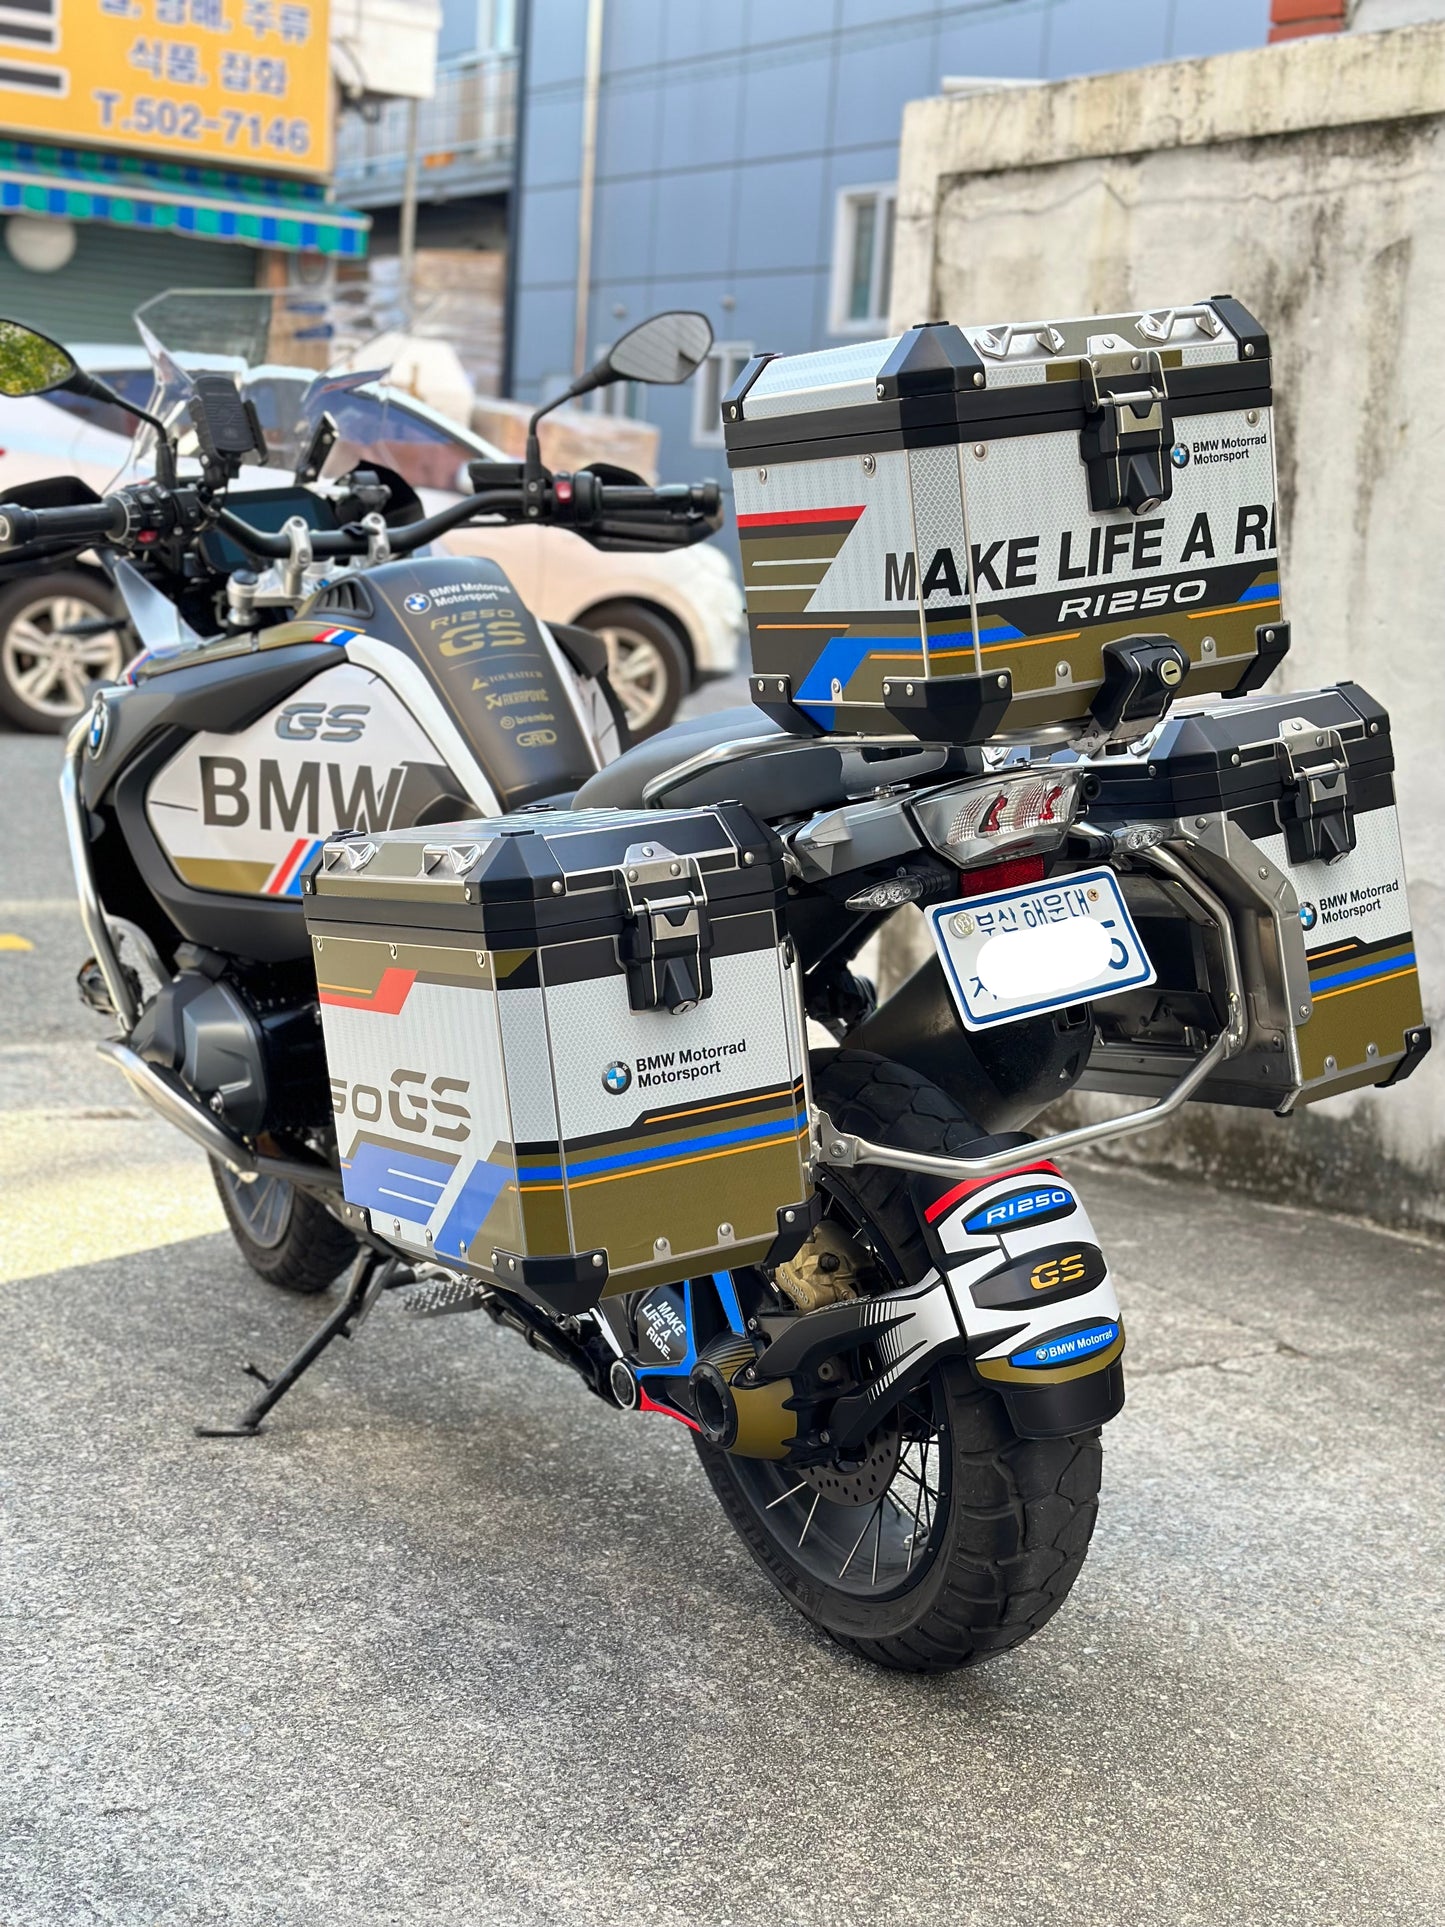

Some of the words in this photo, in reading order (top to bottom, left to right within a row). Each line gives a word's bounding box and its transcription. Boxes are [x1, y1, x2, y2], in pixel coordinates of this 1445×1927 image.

[95, 91, 310, 154] T.502-7146
[1193, 440, 1219, 453] BMW
[1222, 434, 1267, 449] Motorrad
[1194, 449, 1249, 465] Motorsport
[885, 536, 1039, 601] MAKE
[1058, 518, 1165, 581] LIFE
[1180, 512, 1215, 563] A
[429, 584, 461, 598] BMW
[461, 582, 511, 595] Motorrad
[434, 592, 499, 607] Motorsport
[1057, 579, 1208, 623] R1250
[430, 609, 516, 631] R1250
[439, 621, 527, 657] GS
[275, 702, 371, 742] GS
[515, 711, 555, 725] brembo
[199, 755, 405, 835] BMW
[1319, 893, 1347, 911] BMW
[1350, 879, 1399, 902] Motorrad
[1321, 899, 1381, 924] Motorsport
[975, 906, 1019, 936] 부산
[1020, 888, 1090, 928] 해운대
[636, 1052, 675, 1072] BMW
[679, 1039, 747, 1064] Motorrad
[638, 1060, 721, 1088] Motorsport
[986, 1191, 1066, 1224] R1250
[1030, 1254, 1085, 1290] GS
[642, 1303, 665, 1331] LIFE
[660, 1329, 672, 1342] A
[657, 1301, 686, 1337] MAKE
[646, 1326, 671, 1360] RIDE.
[1049, 1340, 1075, 1358] BMW
[1077, 1328, 1113, 1349] Motorrad
